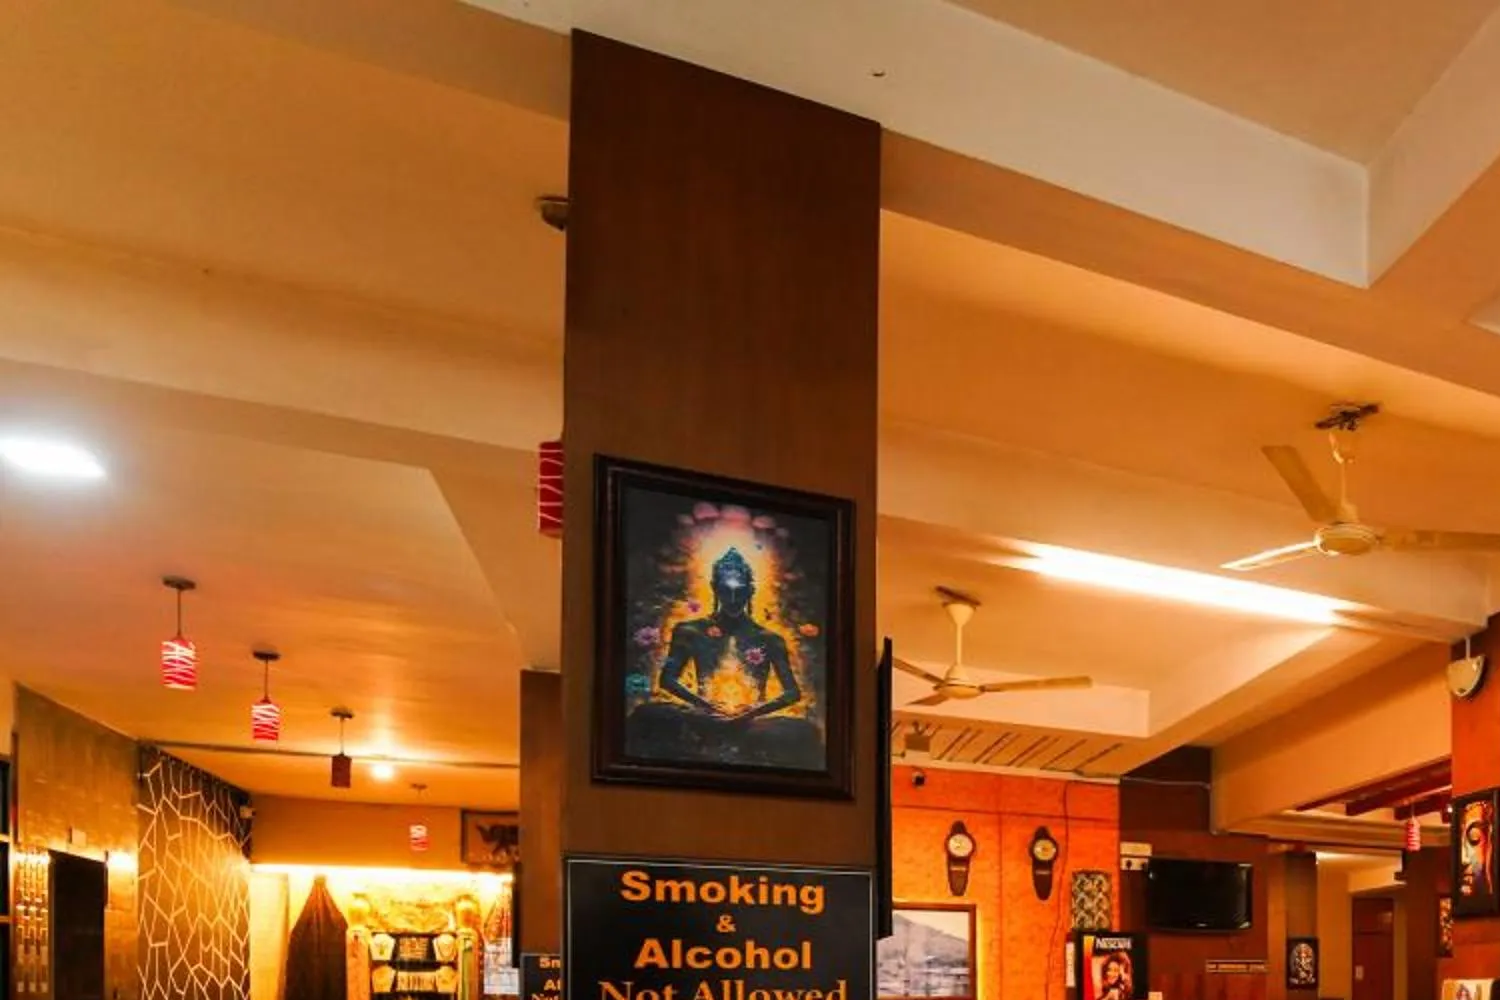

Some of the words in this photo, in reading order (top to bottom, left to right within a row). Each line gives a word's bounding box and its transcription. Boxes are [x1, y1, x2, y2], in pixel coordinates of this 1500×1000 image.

[621, 870, 825, 914] Smoking
[715, 914, 737, 933] &
[633, 938, 812, 969] Alcohol
